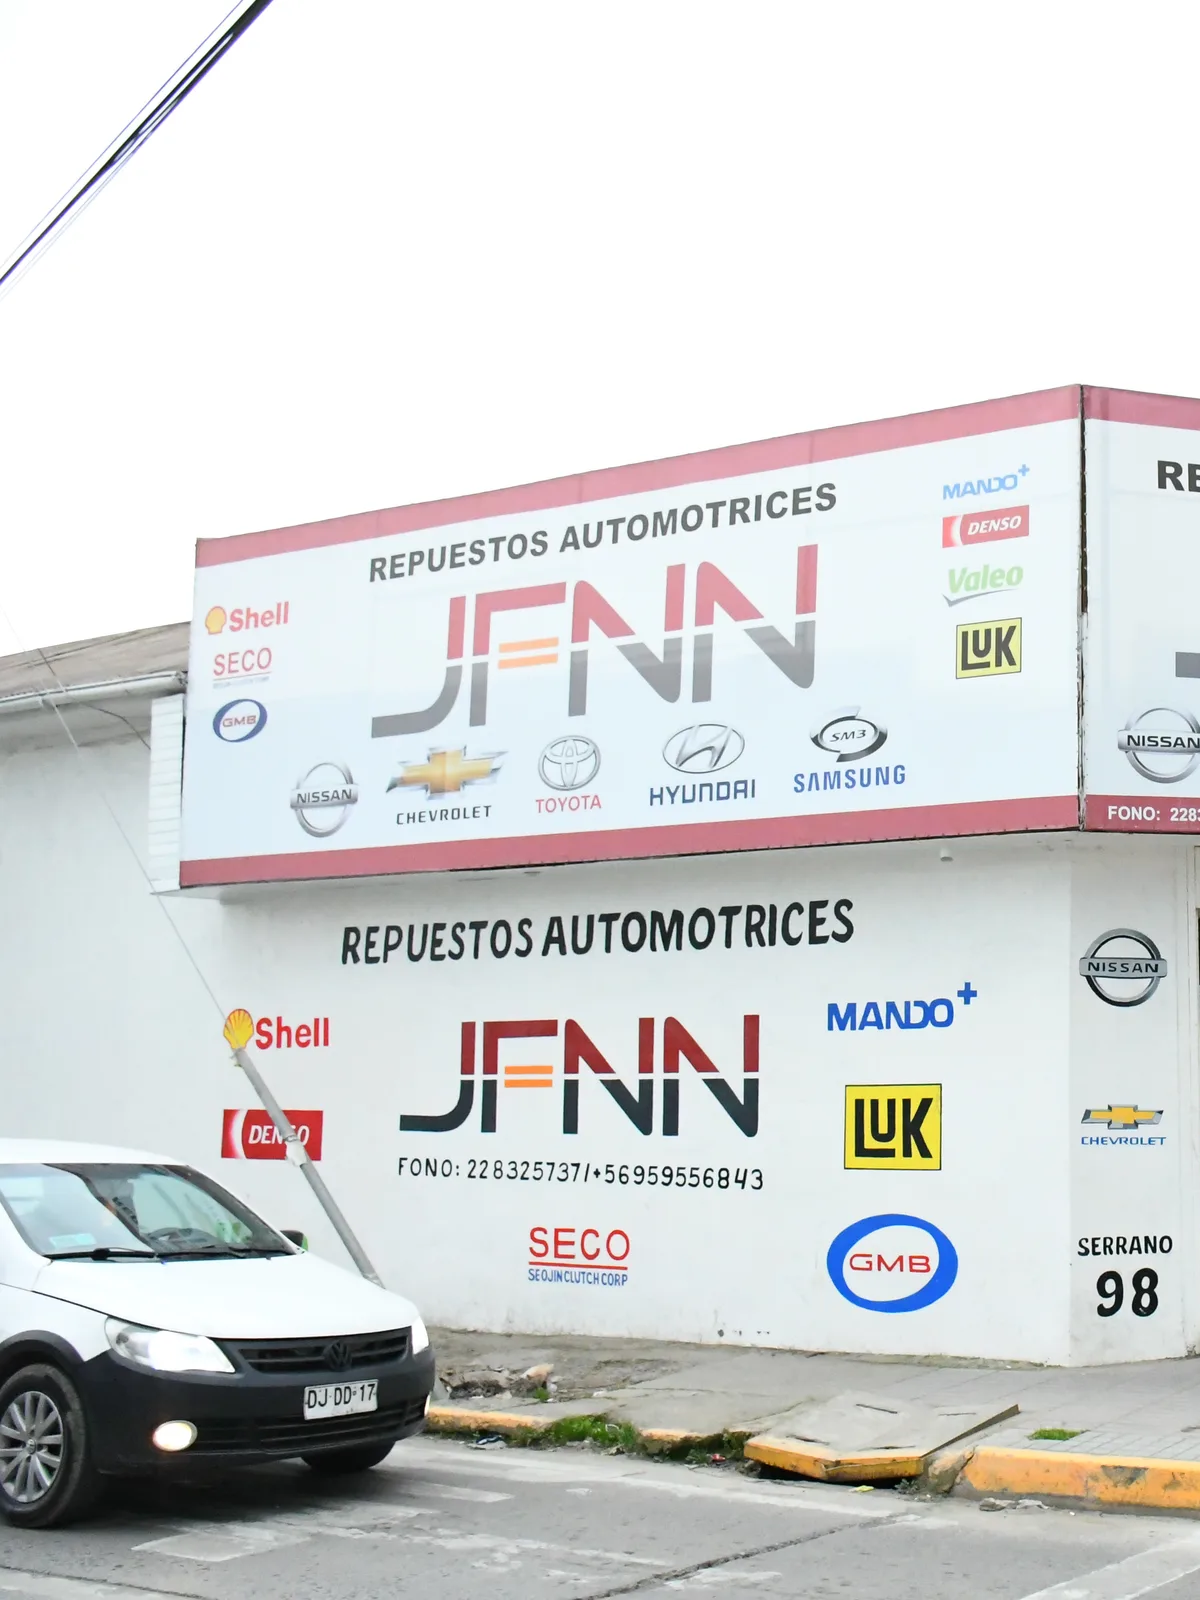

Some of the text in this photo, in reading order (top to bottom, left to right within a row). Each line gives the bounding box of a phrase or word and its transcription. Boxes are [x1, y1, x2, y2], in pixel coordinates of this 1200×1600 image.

[369, 482, 837, 583] REPUESTOS AUTOMOTRICES
[967, 516, 1022, 536] DENSO
[946, 564, 1024, 594] Valeo
[229, 601, 290, 632] Shell
[371, 544, 819, 738] JFNN
[213, 647, 272, 676] SECO
[222, 715, 257, 728] GMB
[831, 729, 867, 743] SM3
[1127, 734, 1200, 750] NISSAN
[793, 764, 906, 793] SAMSUNG
[296, 788, 353, 804] NISSAN
[649, 779, 756, 806] HYUNDAI
[396, 805, 492, 825] CHEVROLET
[535, 794, 602, 814] TOYOTA
[1107, 805, 1161, 821] FONO:
[341, 898, 855, 965] REPUESTOS AUTOMOTRICES
[1087, 961, 1159, 974] NISSAN
[255, 1016, 330, 1050] Shell
[399, 1014, 761, 1138] JFNN
[247, 1124, 310, 1146] DENO
[1080, 1136, 1167, 1146] CHEVROLET
[528, 1226, 631, 1261] SECO
[1077, 1235, 1173, 1257] SERRANO
[849, 1252, 931, 1274] GMB
[1096, 1267, 1159, 1318] 98
